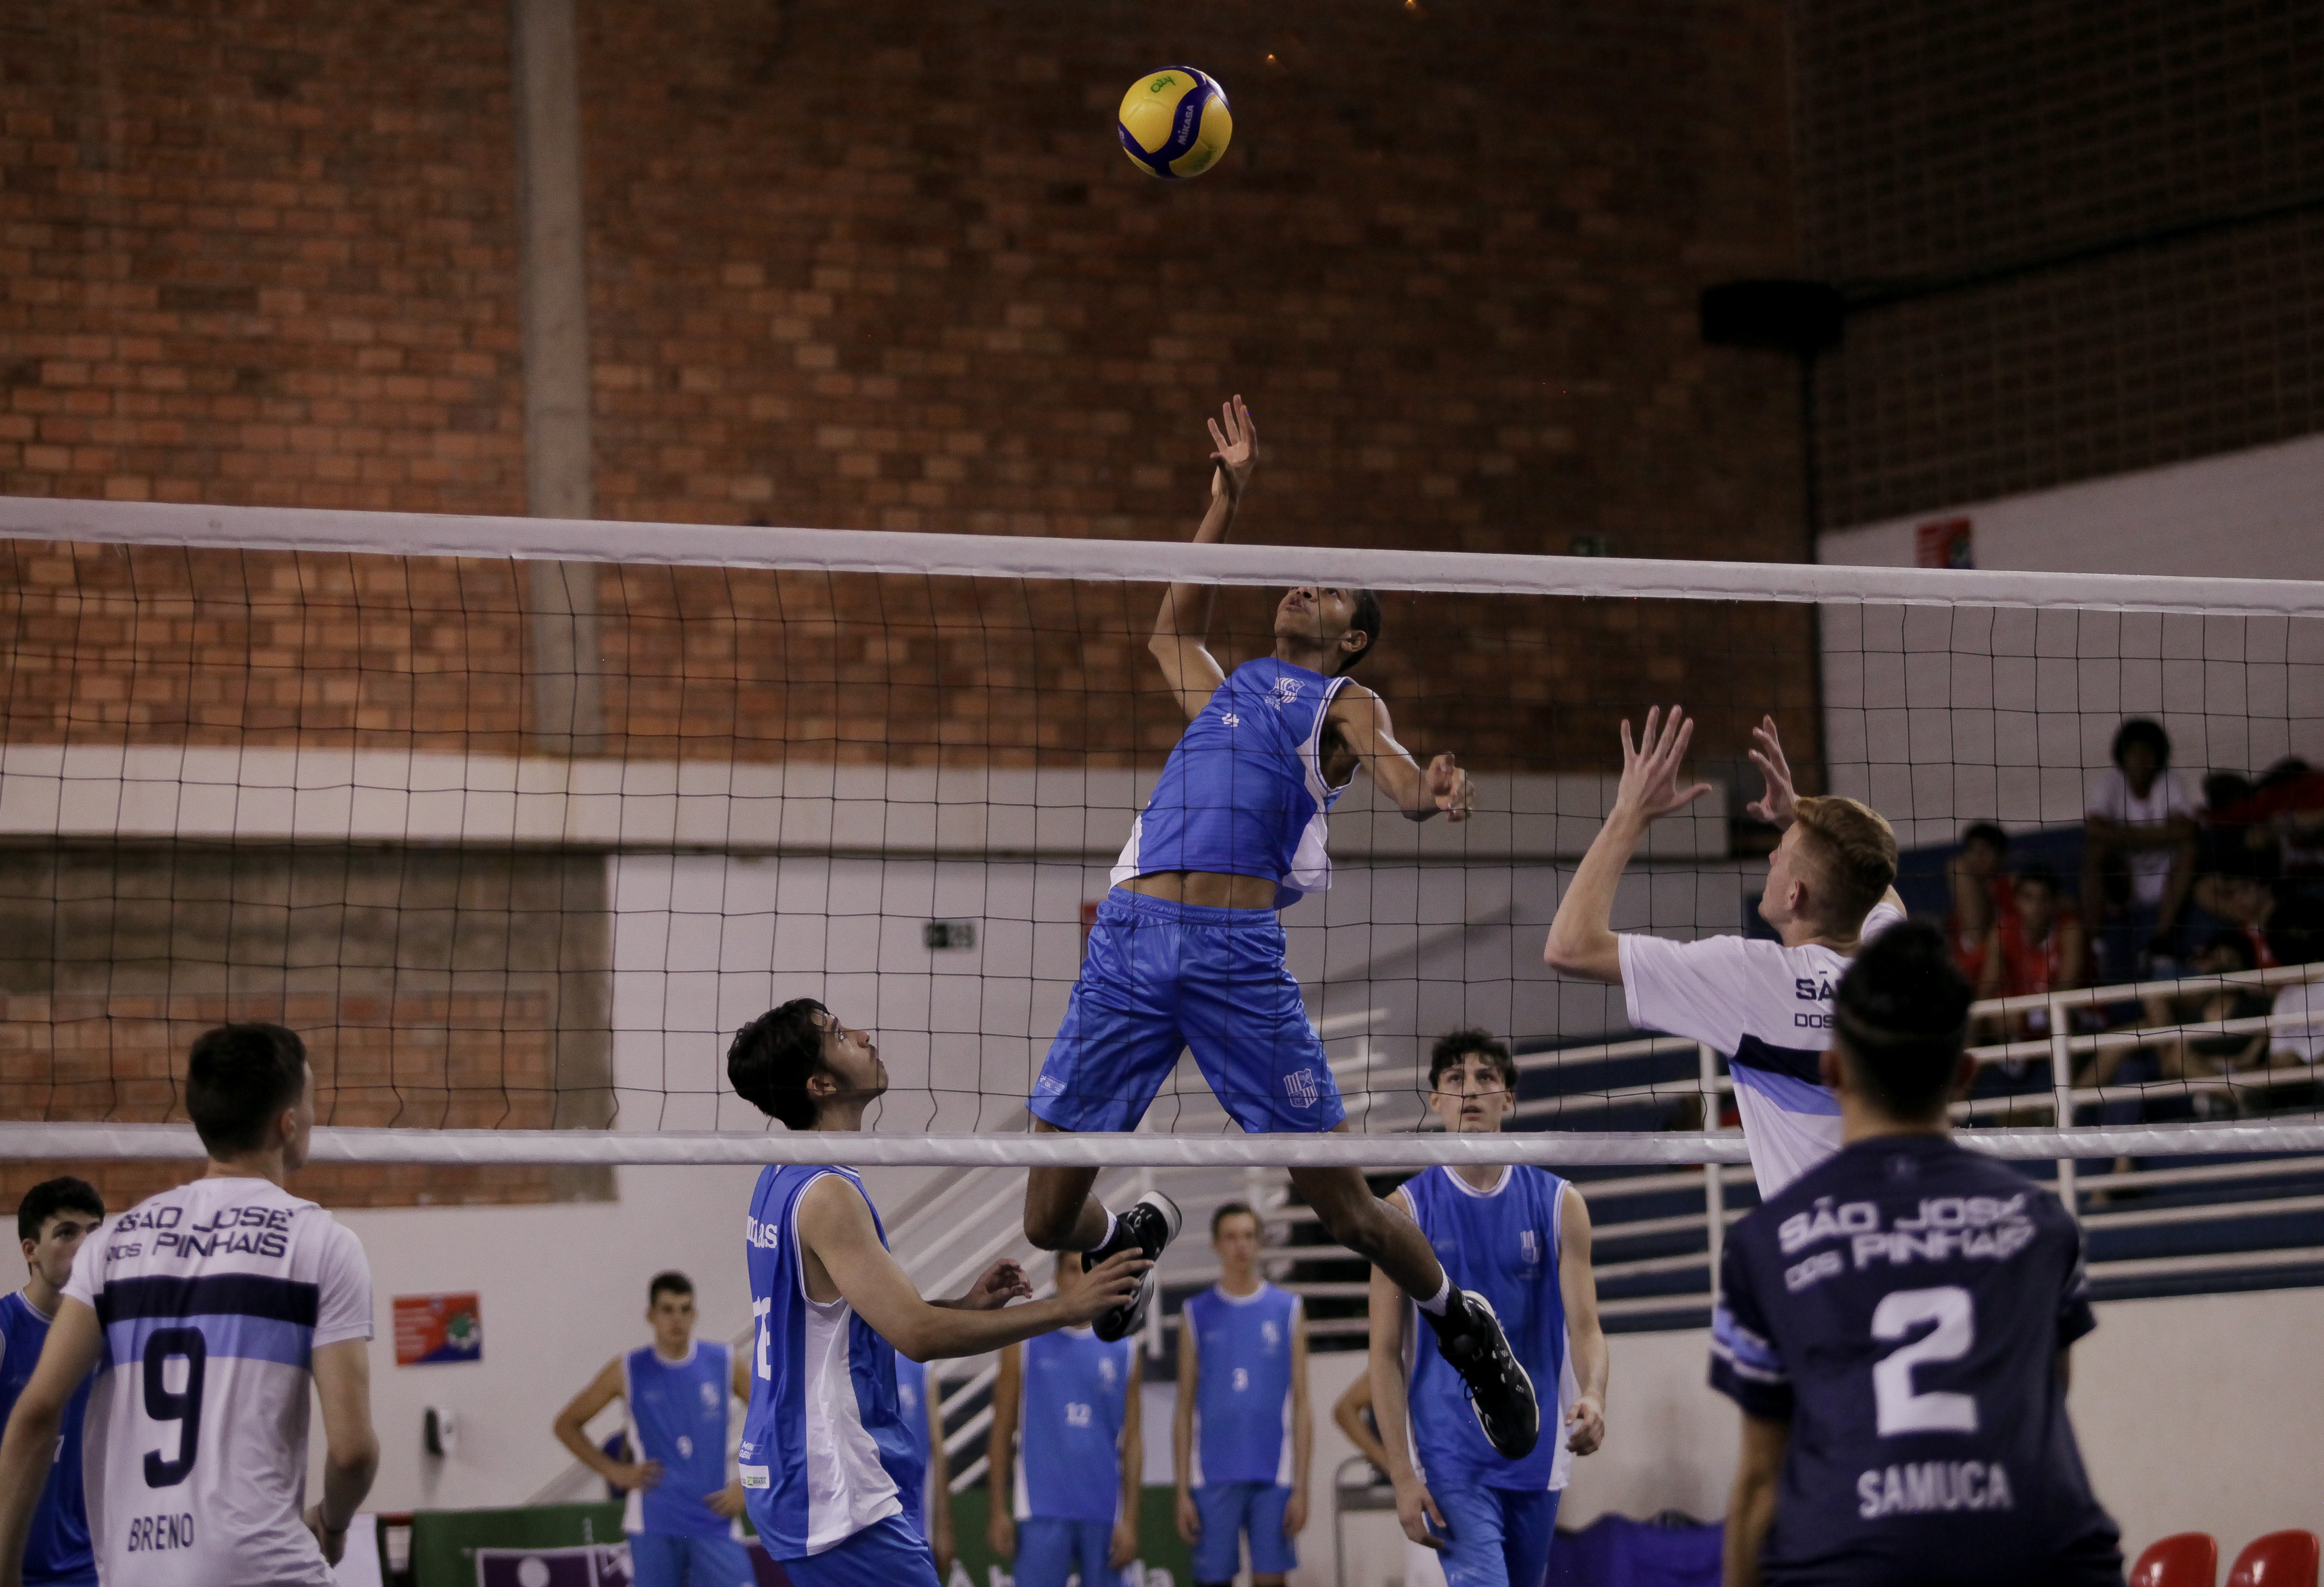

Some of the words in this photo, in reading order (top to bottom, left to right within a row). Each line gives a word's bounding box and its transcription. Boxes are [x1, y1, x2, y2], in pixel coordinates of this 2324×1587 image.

[1796, 970, 1839, 1001] SÃ
[115, 1202, 183, 1233] SÃO
[193, 1206, 294, 1232] JOSÉ
[1778, 1195, 1879, 1255] SÃO
[152, 1231, 288, 1258] PINHAIS
[1871, 1284, 1980, 1438] 2
[144, 1326, 206, 1488] 9
[1856, 1460, 2014, 1519] SAMUCA
[128, 1513, 194, 1552] BRENO
